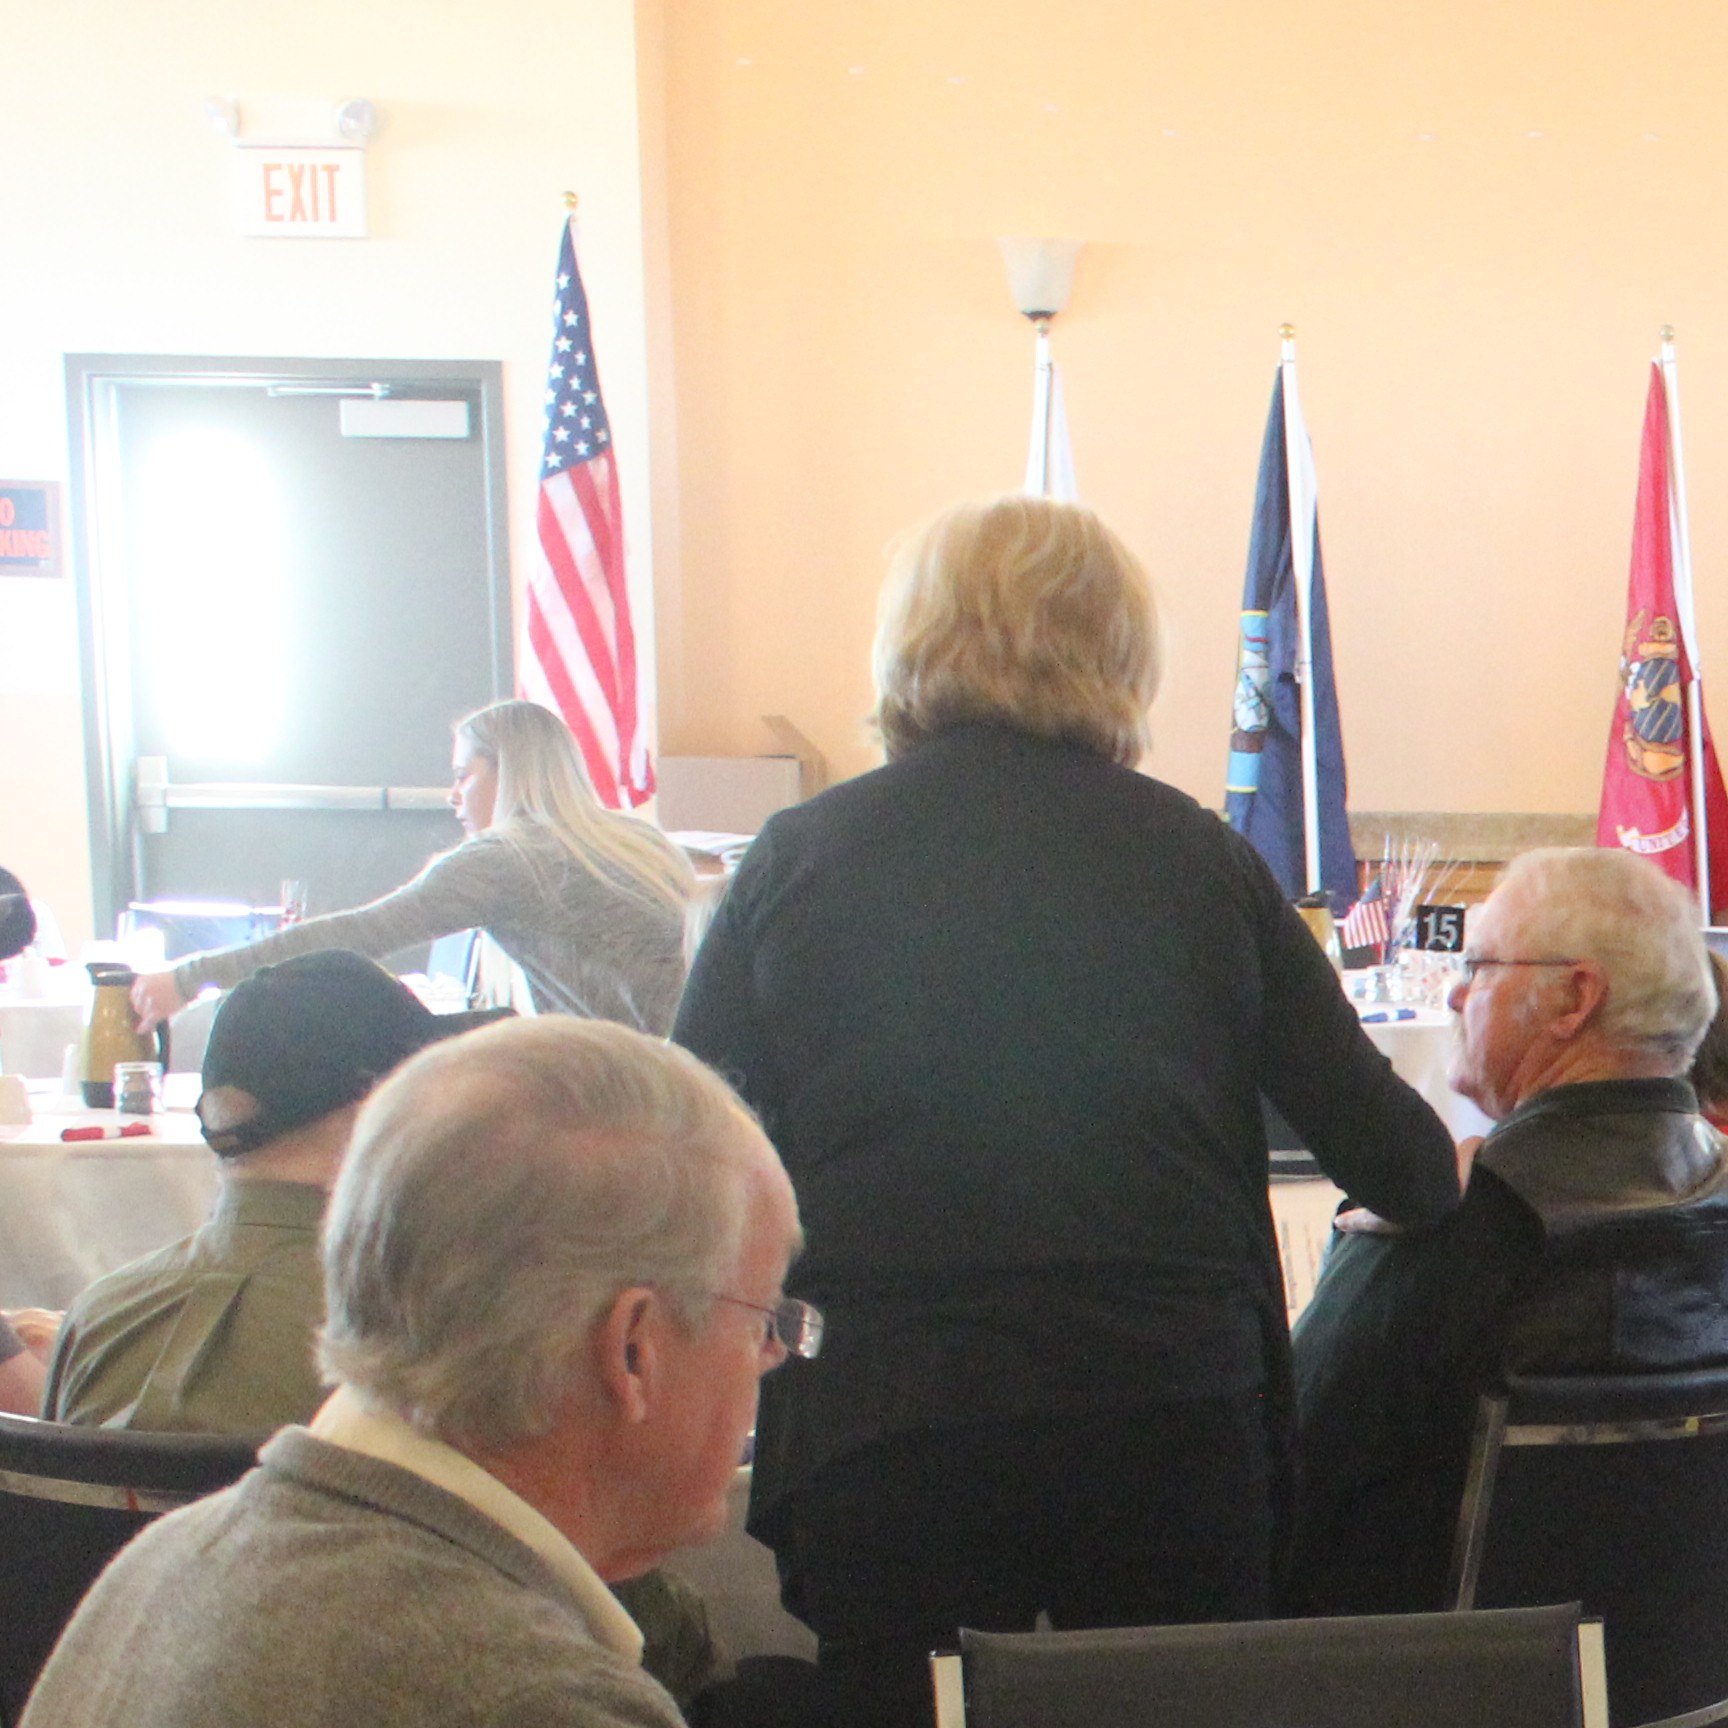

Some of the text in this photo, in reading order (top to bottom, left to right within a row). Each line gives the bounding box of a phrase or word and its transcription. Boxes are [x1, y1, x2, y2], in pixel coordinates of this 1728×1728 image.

[261, 164, 341, 224] EXIT
[0, 497, 16, 527] O
[0, 529, 50, 558] KING
[1423, 912, 1458, 948] 15
